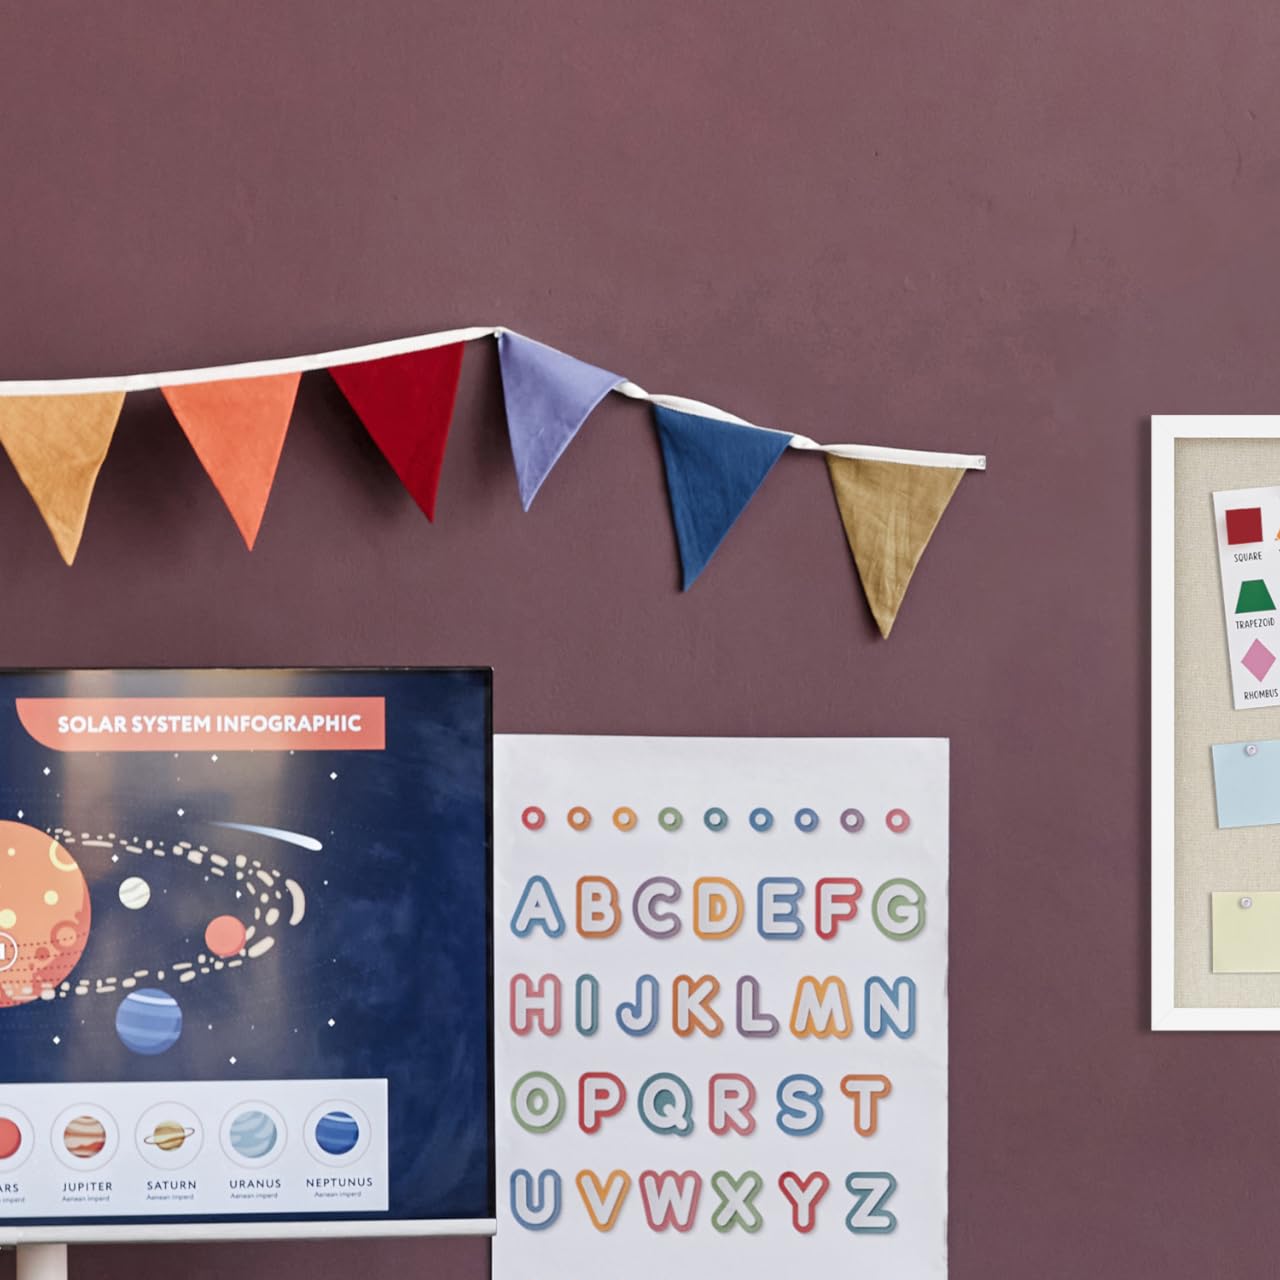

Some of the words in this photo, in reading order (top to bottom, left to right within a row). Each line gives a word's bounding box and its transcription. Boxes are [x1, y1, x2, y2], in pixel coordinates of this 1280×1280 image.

[1234, 552, 1262, 562] SQUARE
[1244, 689, 1278, 699] RHOMBUS
[58, 715, 127, 733] SOLAR
[131, 714, 211, 733] SYSTEM
[216, 713, 362, 732] INFOGRAPHIC
[64, 1182, 112, 1191] JUPITER
[147, 1181, 196, 1190] SATURN
[230, 1179, 281, 1189] URANUS
[307, 1178, 372, 1187] NEPTUNUS
